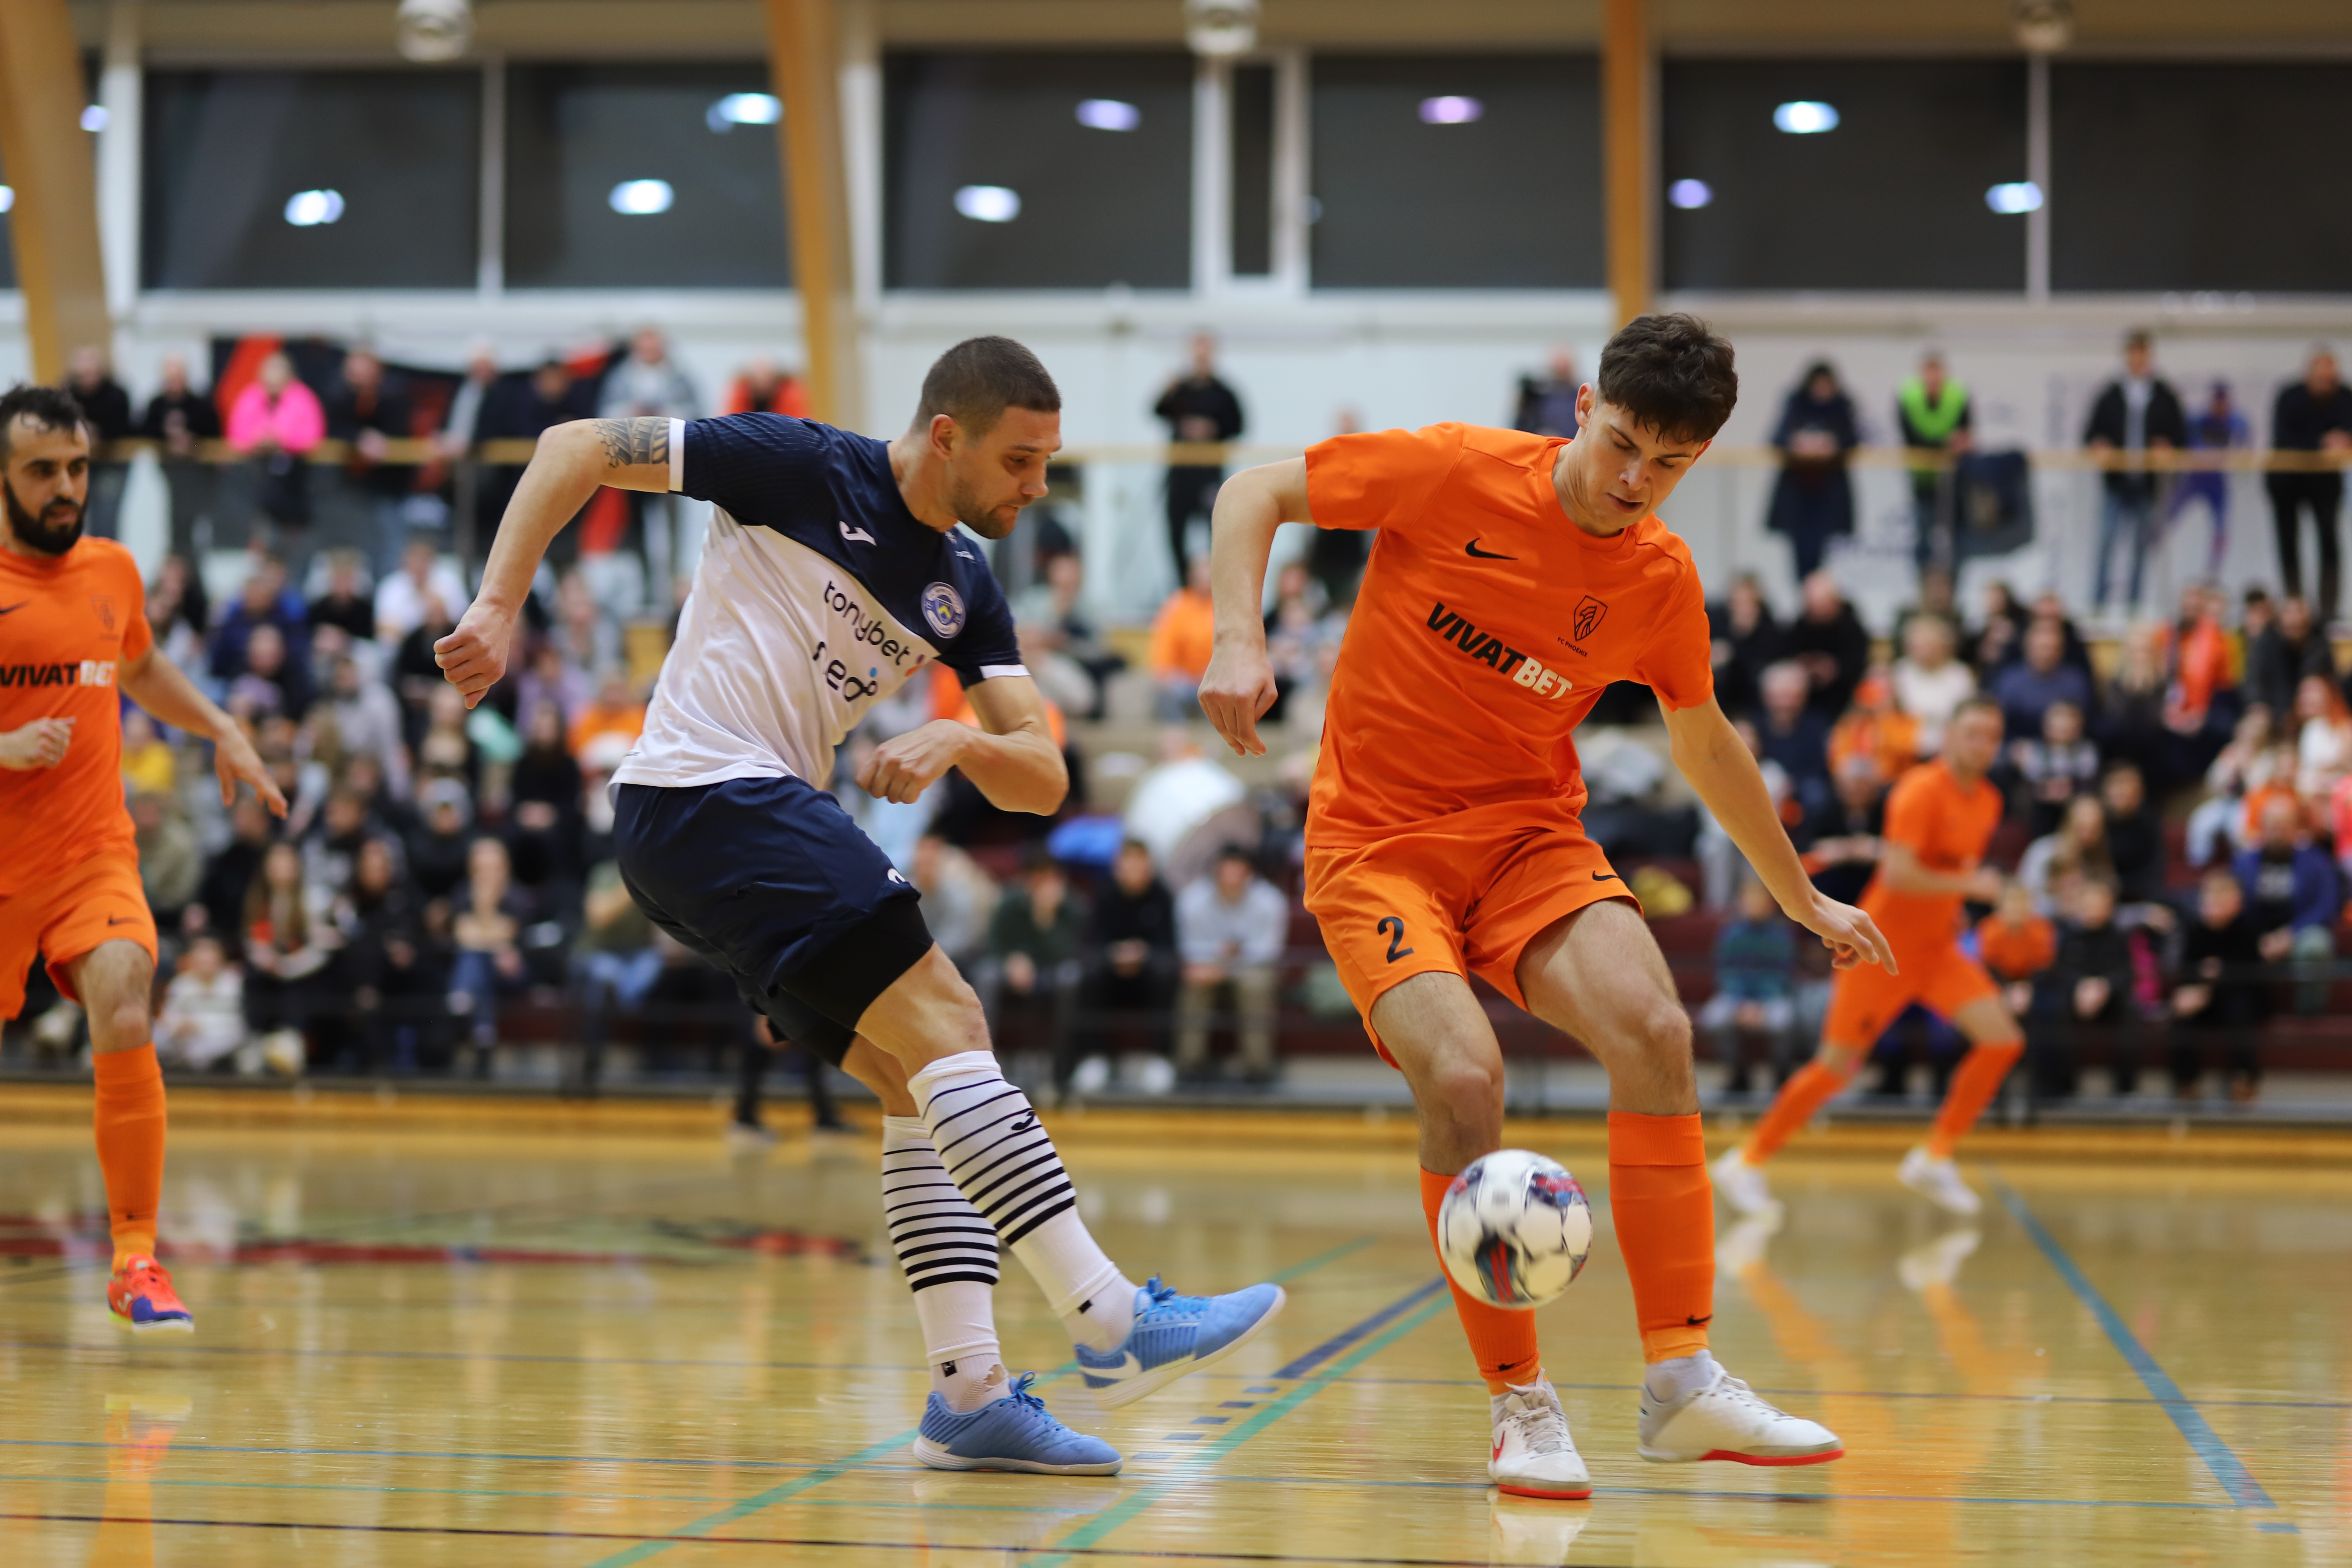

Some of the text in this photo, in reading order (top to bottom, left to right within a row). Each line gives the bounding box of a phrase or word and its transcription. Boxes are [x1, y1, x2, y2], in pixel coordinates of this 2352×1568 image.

[824, 580, 911, 666] tonybet
[1426, 601, 1573, 700] VIVATBET
[1565, 641, 1588, 658] PHOENIX
[1377, 916, 1414, 964] 2
